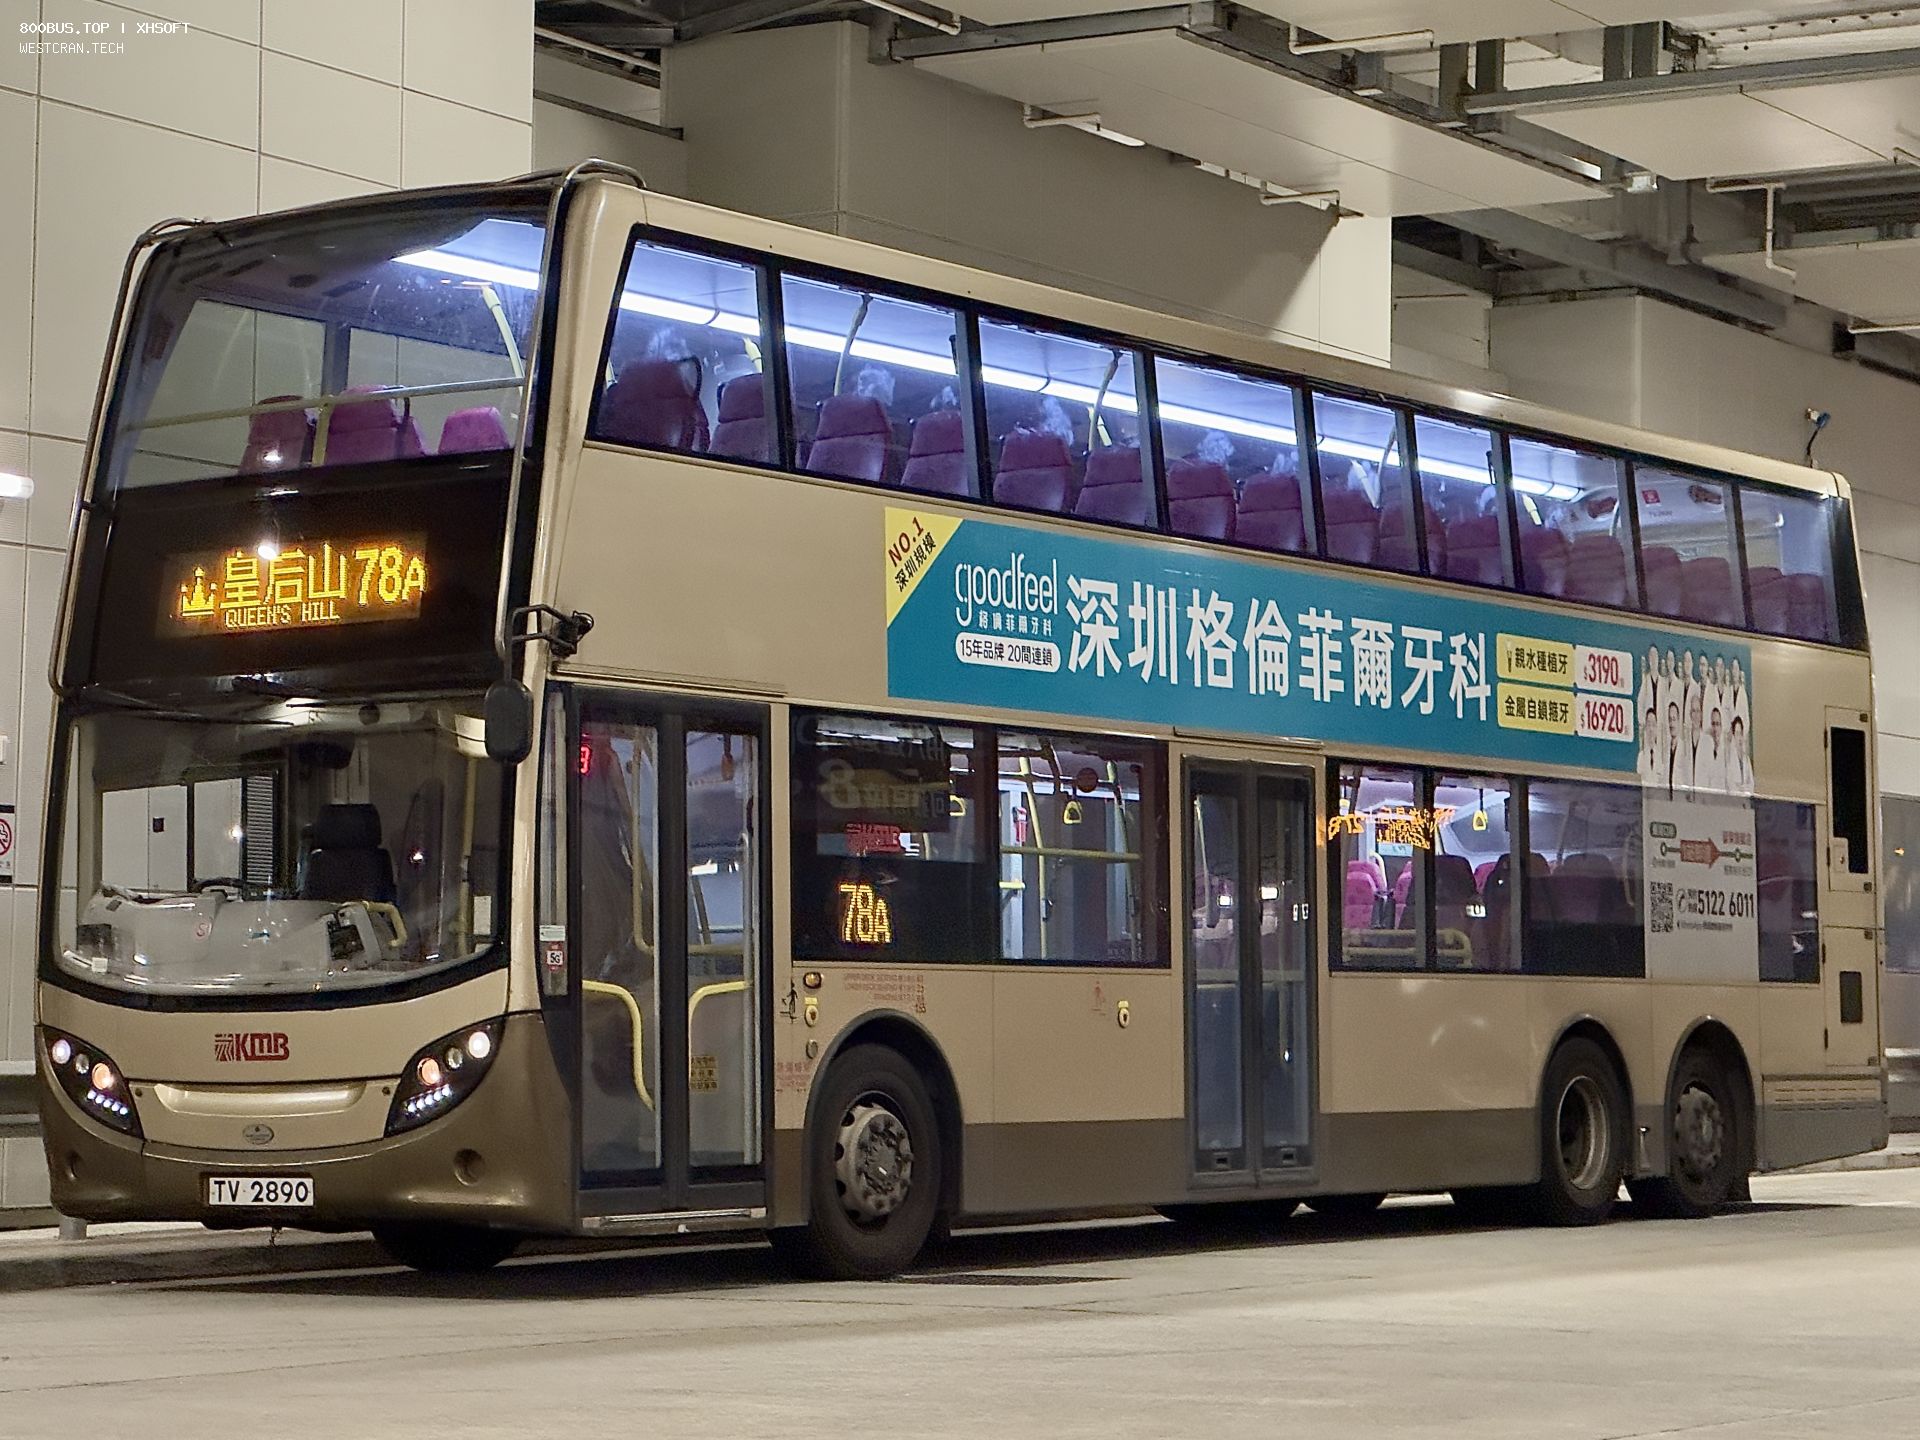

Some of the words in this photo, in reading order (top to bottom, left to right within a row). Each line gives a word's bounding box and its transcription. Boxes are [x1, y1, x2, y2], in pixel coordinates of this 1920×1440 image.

[888, 516, 925, 567] NO.1
[895, 532, 937, 592] 深圳規模
[219, 543, 346, 608] 皇后山
[354, 545, 427, 606] 78A
[955, 552, 1058, 627] goodfeel
[225, 604, 292, 629] QUEEN'S
[301, 601, 340, 623] HILL
[960, 639, 1005, 662] 15年品牌
[1007, 644, 1053, 667] 20間連鎖
[1065, 574, 1491, 721] 深圳格倫菲爾牙科
[839, 883, 893, 943] 78A
[1698, 889, 1725, 915] 5122
[1729, 892, 1754, 918] 6011
[236, 1032, 290, 1062] KMB
[213, 1180, 240, 1202] TV
[250, 1180, 309, 1203] 2890
